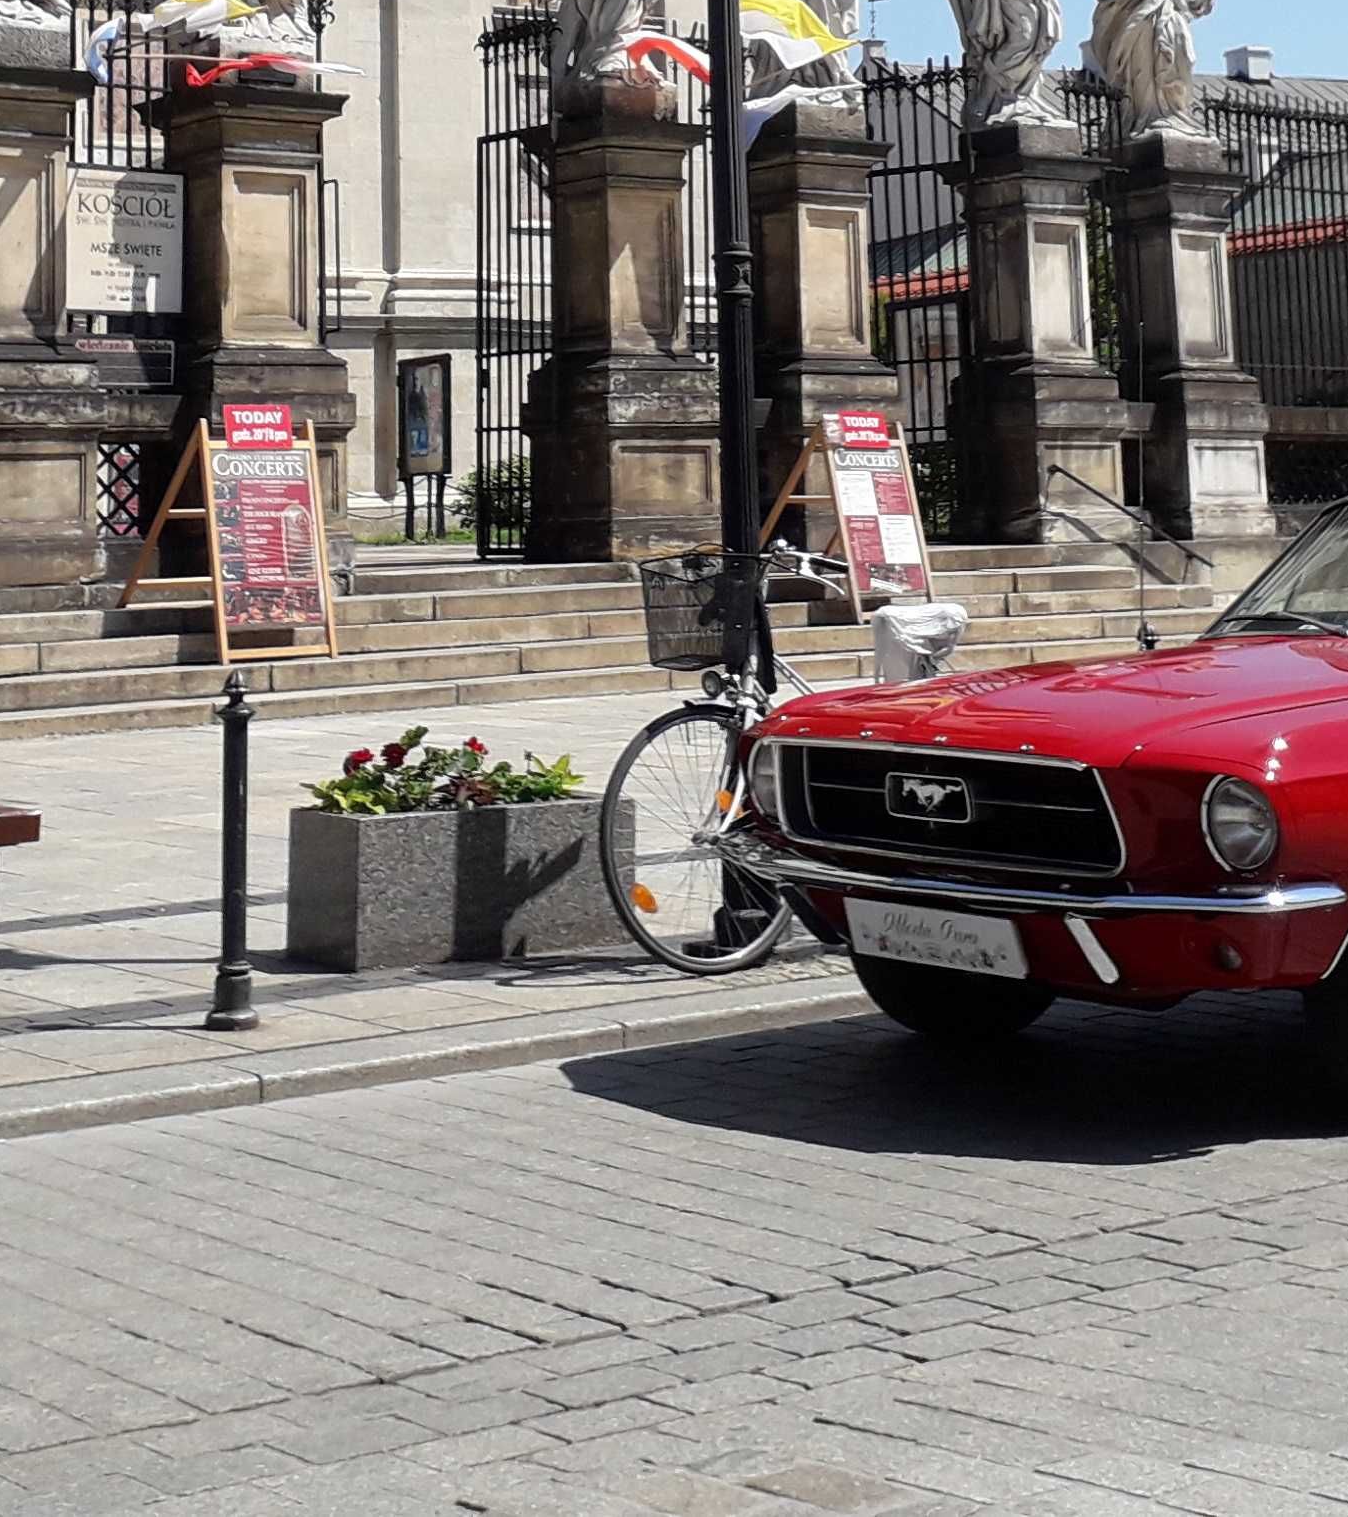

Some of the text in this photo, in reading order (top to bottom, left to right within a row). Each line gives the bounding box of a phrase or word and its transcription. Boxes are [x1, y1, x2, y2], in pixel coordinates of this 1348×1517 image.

[77, 189, 176, 219] KOŚCIÓŁ
[90, 242, 162, 257] MSZE ŚWIĘTE
[231, 411, 283, 424] TODAY
[843, 416, 880, 428] TODAY
[212, 453, 305, 476] CONCERTS
[834, 448, 900, 468] CONCERTS
